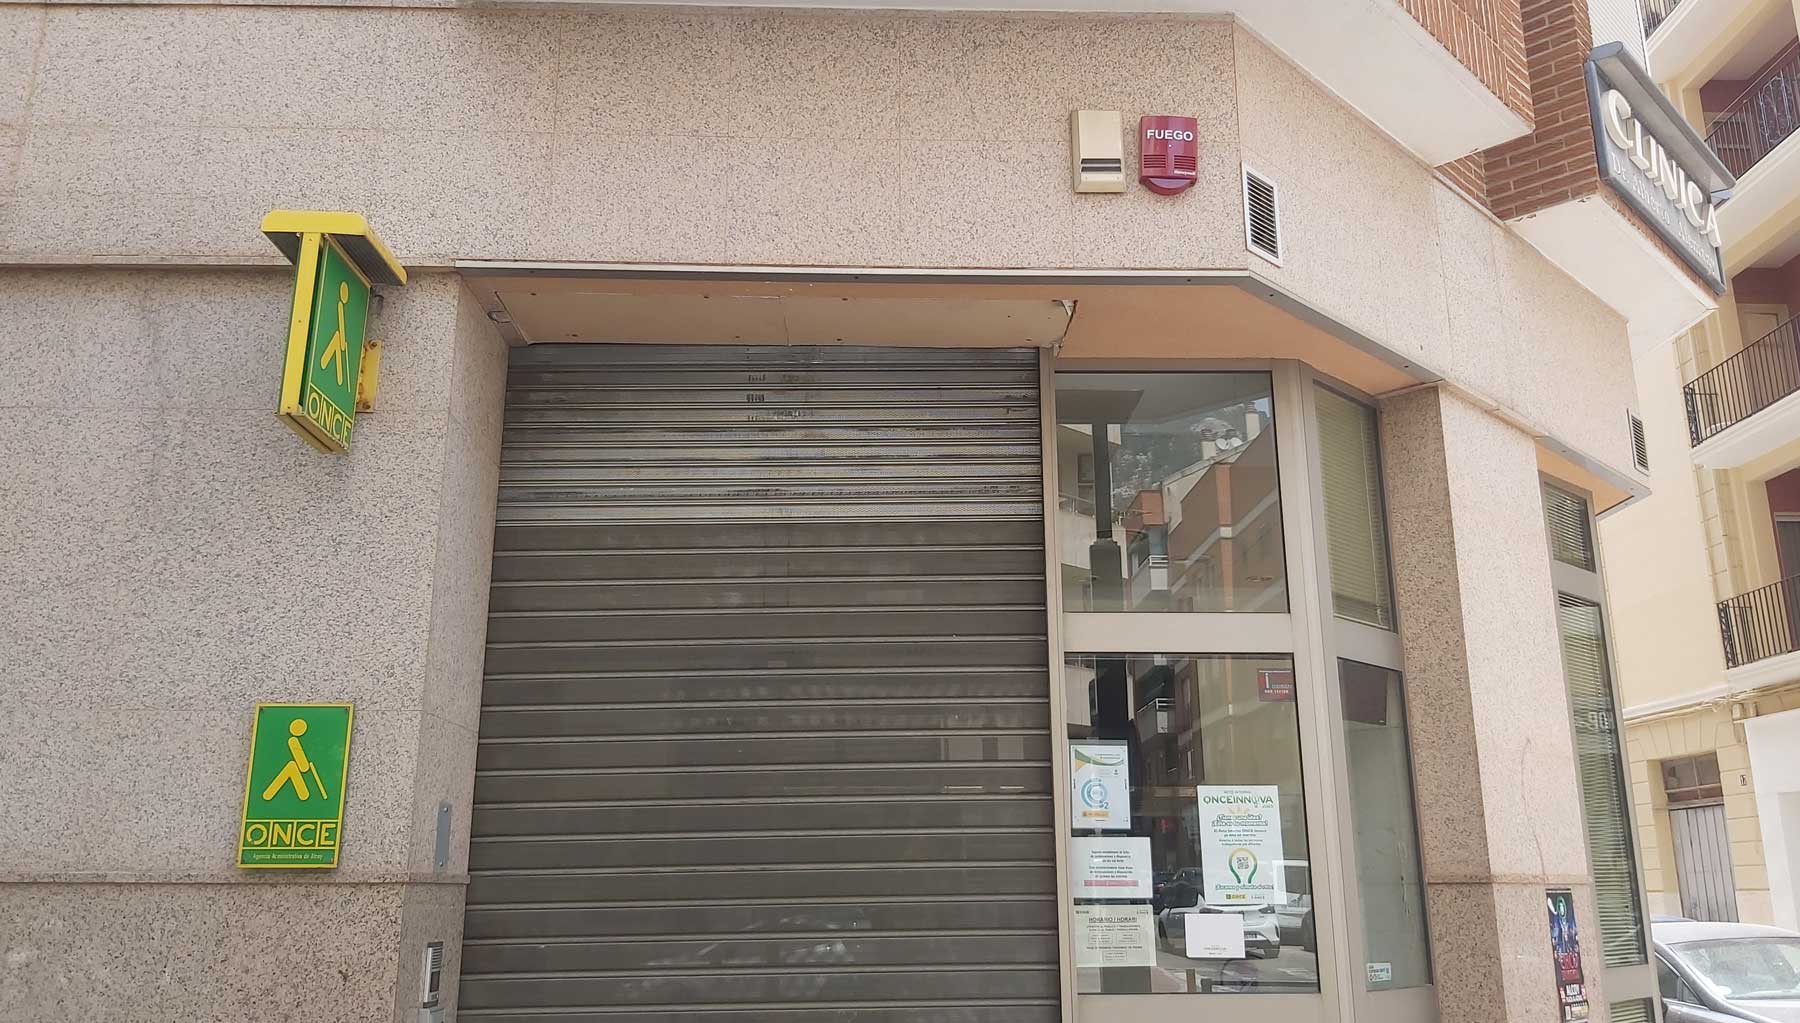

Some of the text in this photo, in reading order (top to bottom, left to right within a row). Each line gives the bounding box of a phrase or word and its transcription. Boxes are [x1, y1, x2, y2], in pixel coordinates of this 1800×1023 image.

[1146, 129, 1193, 141] FUEGO
[1603, 89, 1720, 246] CLINICA
[308, 392, 351, 449] ONCE
[246, 823, 336, 846] ONCE
